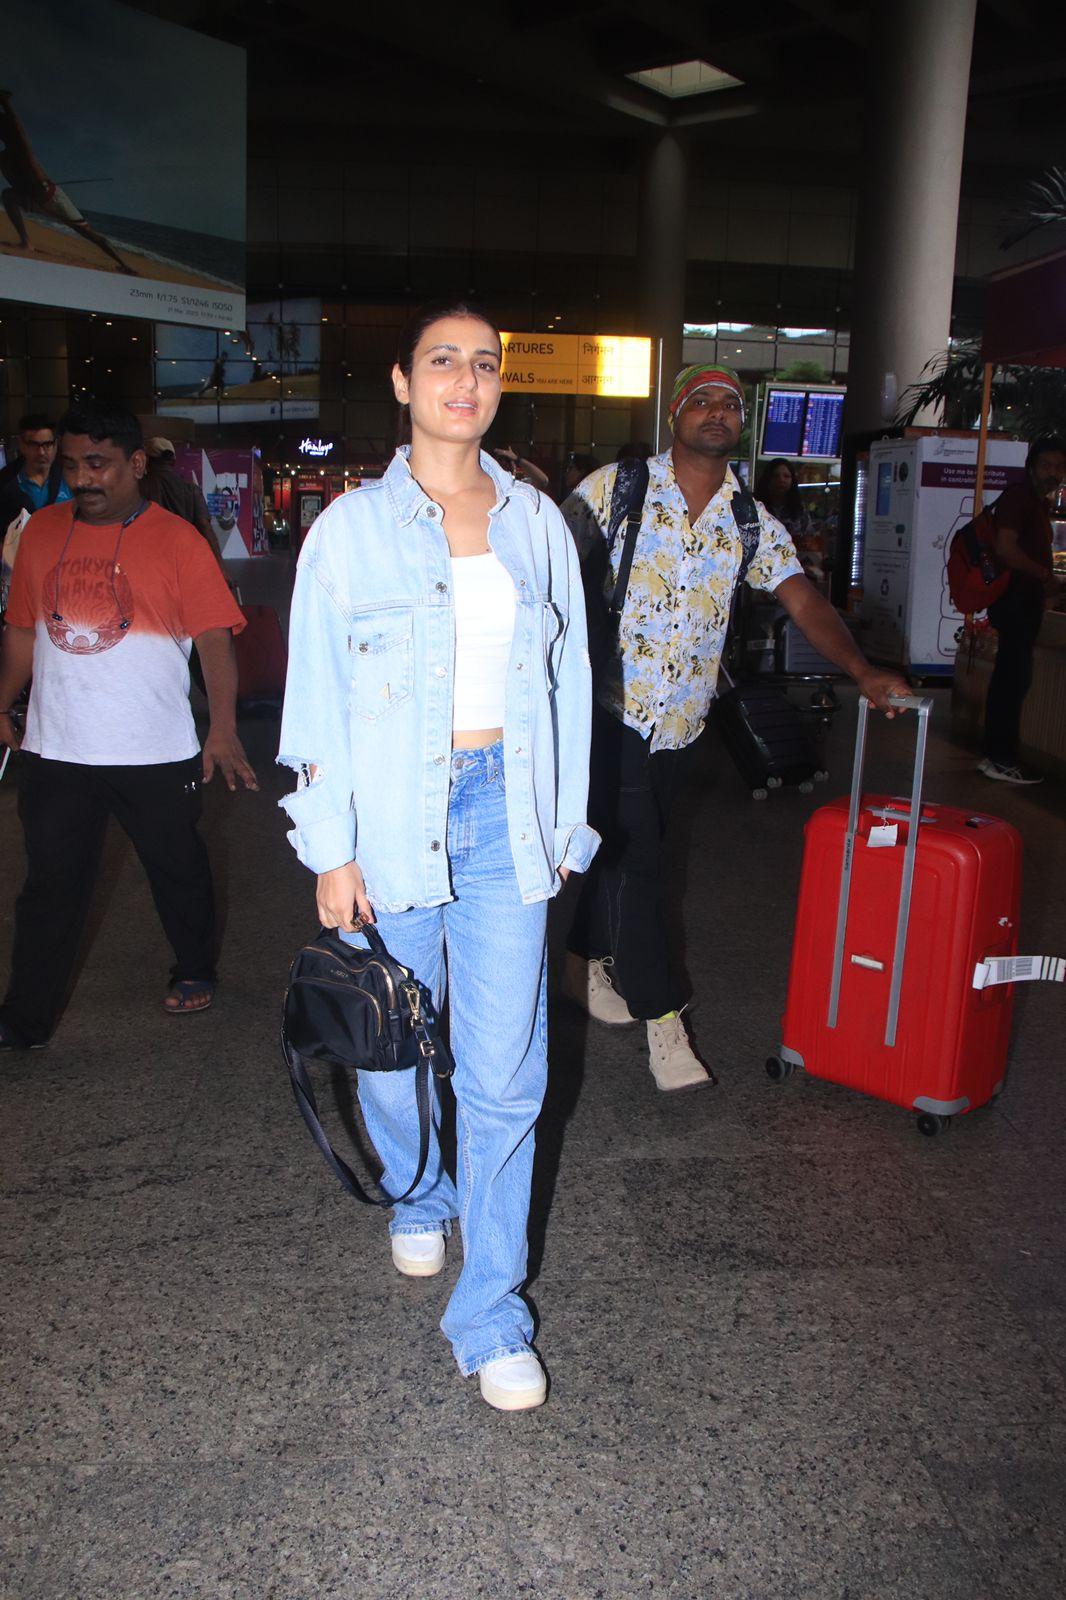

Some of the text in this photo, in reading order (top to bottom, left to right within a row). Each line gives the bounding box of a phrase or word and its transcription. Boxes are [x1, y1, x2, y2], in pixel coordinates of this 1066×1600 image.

[130, 290, 153, 299] 23mm
[212, 302, 233, 312] ISO50
[298, 437, 334, 457] Hamleys
[944, 467, 956, 475] Use
[60, 557, 114, 580] TOKYO
